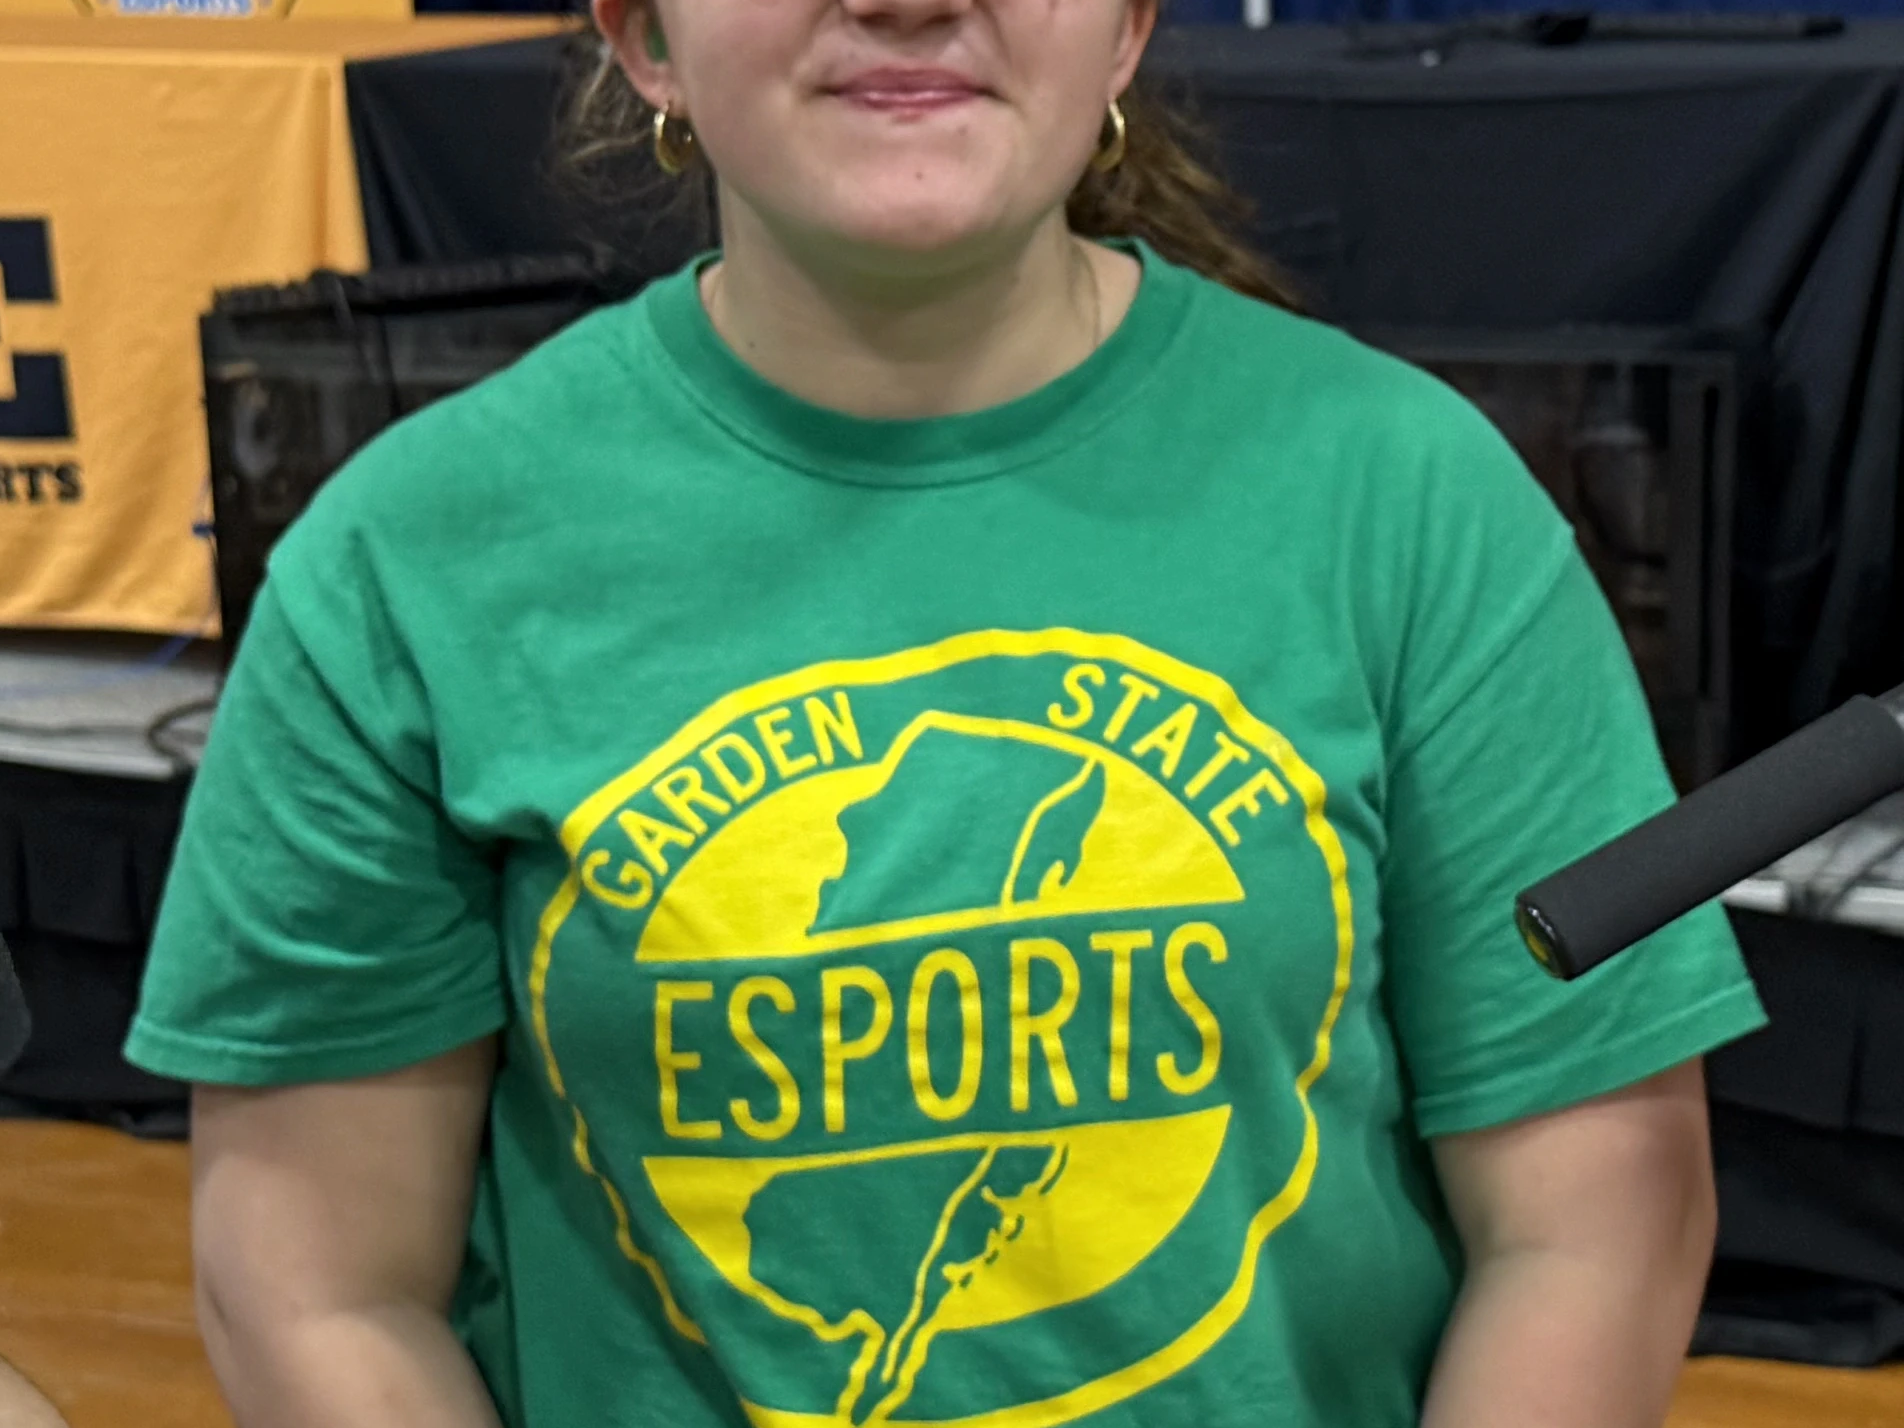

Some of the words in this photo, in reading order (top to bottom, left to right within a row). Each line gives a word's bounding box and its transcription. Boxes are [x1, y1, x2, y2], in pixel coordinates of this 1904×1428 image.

[580, 690, 865, 912] GARDEN
[1047, 662, 1290, 847] STATE
[653, 922, 1228, 1141] ESPORTS
